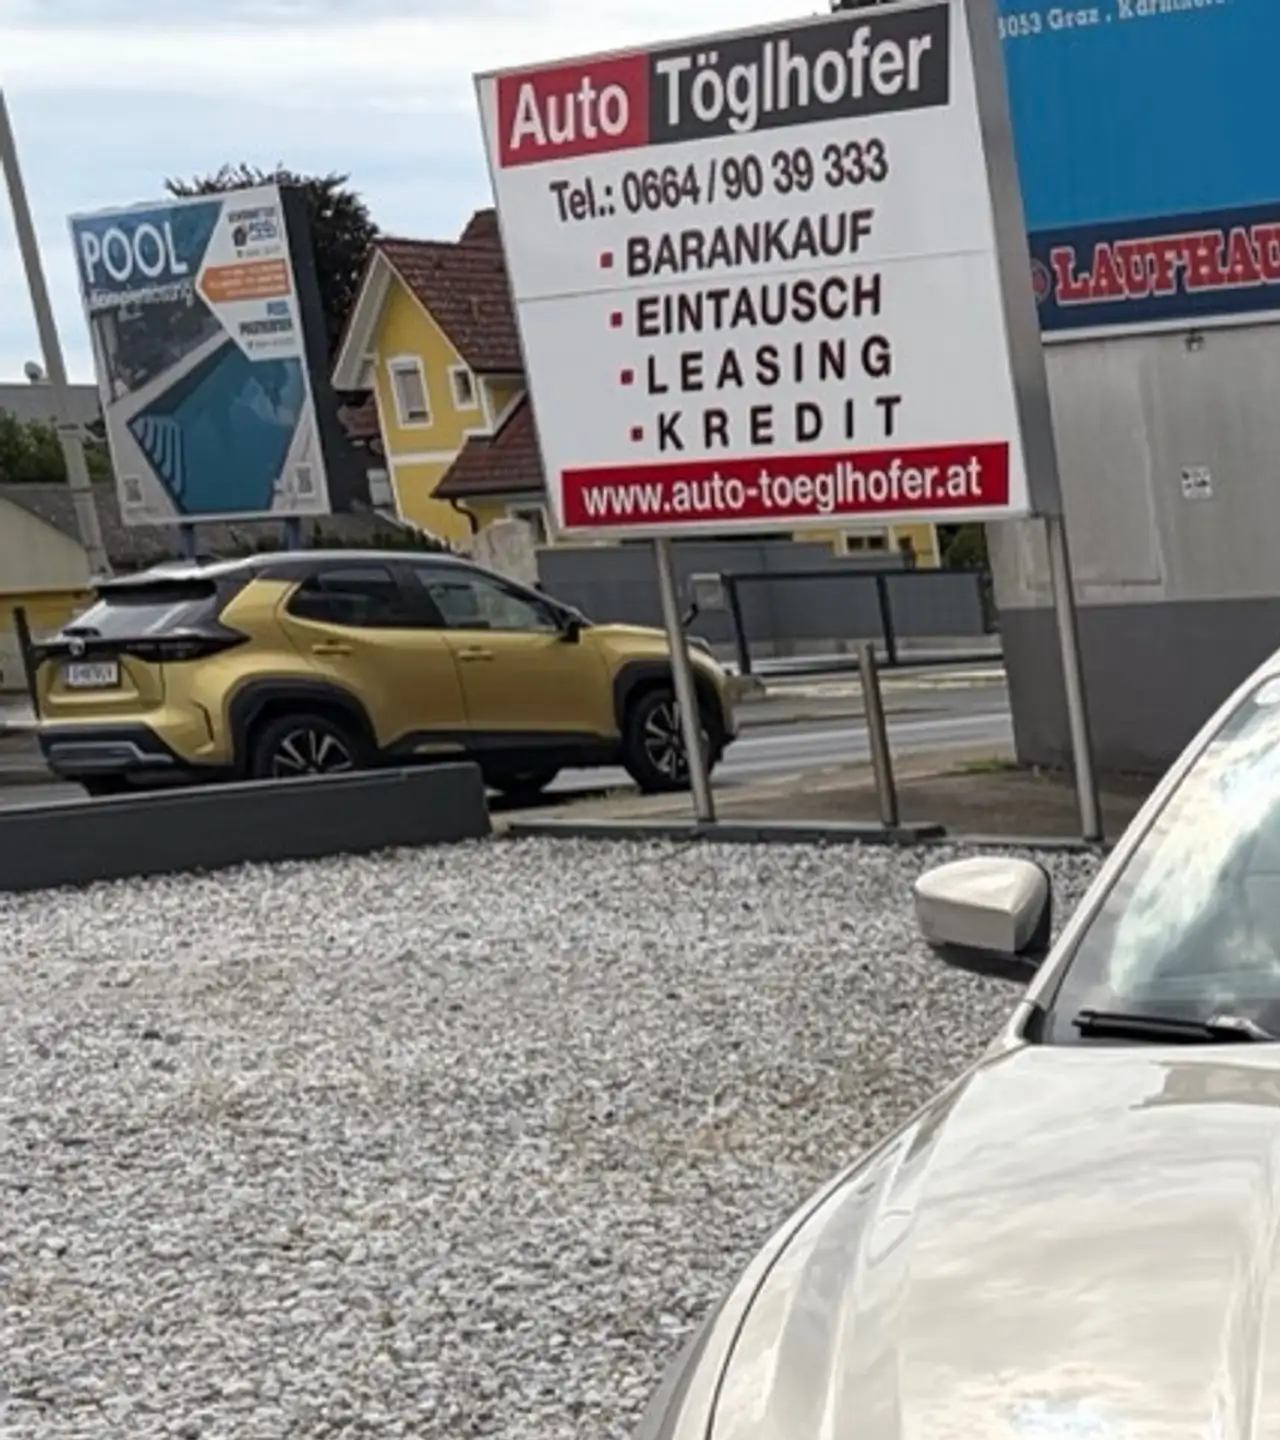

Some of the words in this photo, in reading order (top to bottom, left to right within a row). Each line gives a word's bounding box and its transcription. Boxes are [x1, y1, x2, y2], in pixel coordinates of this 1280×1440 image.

[1048, 7, 1100, 30] Graz
[509, 76, 629, 150] Auto
[656, 27, 932, 132] Töglhofer
[550, 176, 615, 222] Tel.:
[772, 148, 814, 193] 39
[823, 138, 888, 185] 333
[80, 221, 188, 283] POOL
[626, 209, 872, 277] BARANKAUF
[636, 274, 882, 337] EINTAUSCH
[646, 335, 892, 393] LEASING
[657, 396, 901, 451] KREDIT
[582, 456, 981, 515] www.auto-toeglhofer.at
